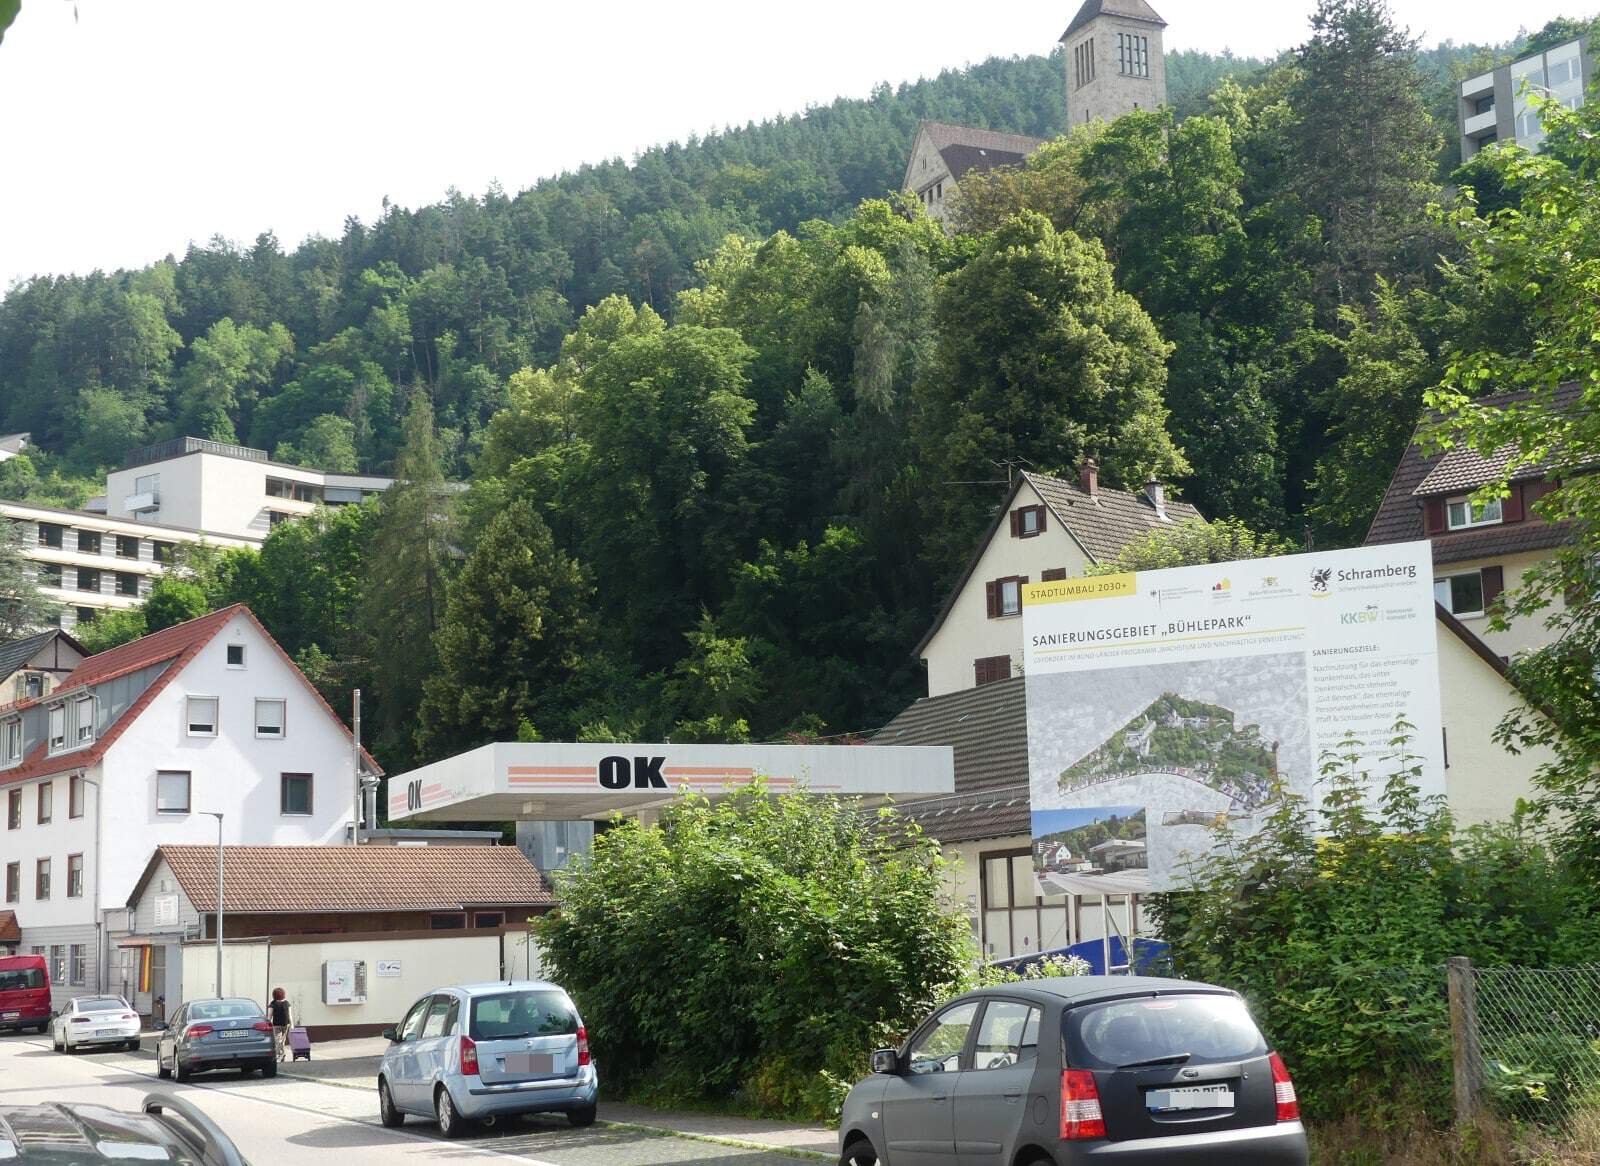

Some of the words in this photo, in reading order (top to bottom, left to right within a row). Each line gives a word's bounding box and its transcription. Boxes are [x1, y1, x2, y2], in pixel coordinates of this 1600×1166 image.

[1337, 564, 1416, 581] Schramberg
[1030, 584, 1095, 599] STADTUMBAU
[1098, 581, 1128, 592] 2030+
[1340, 611, 1377, 624] KKBW
[1032, 624, 1157, 647] SANIERUNGSGEBIET
[1161, 615, 1251, 637] „BÜHLEPARK“
[598, 755, 668, 789] OK
[407, 779, 422, 811] OK
